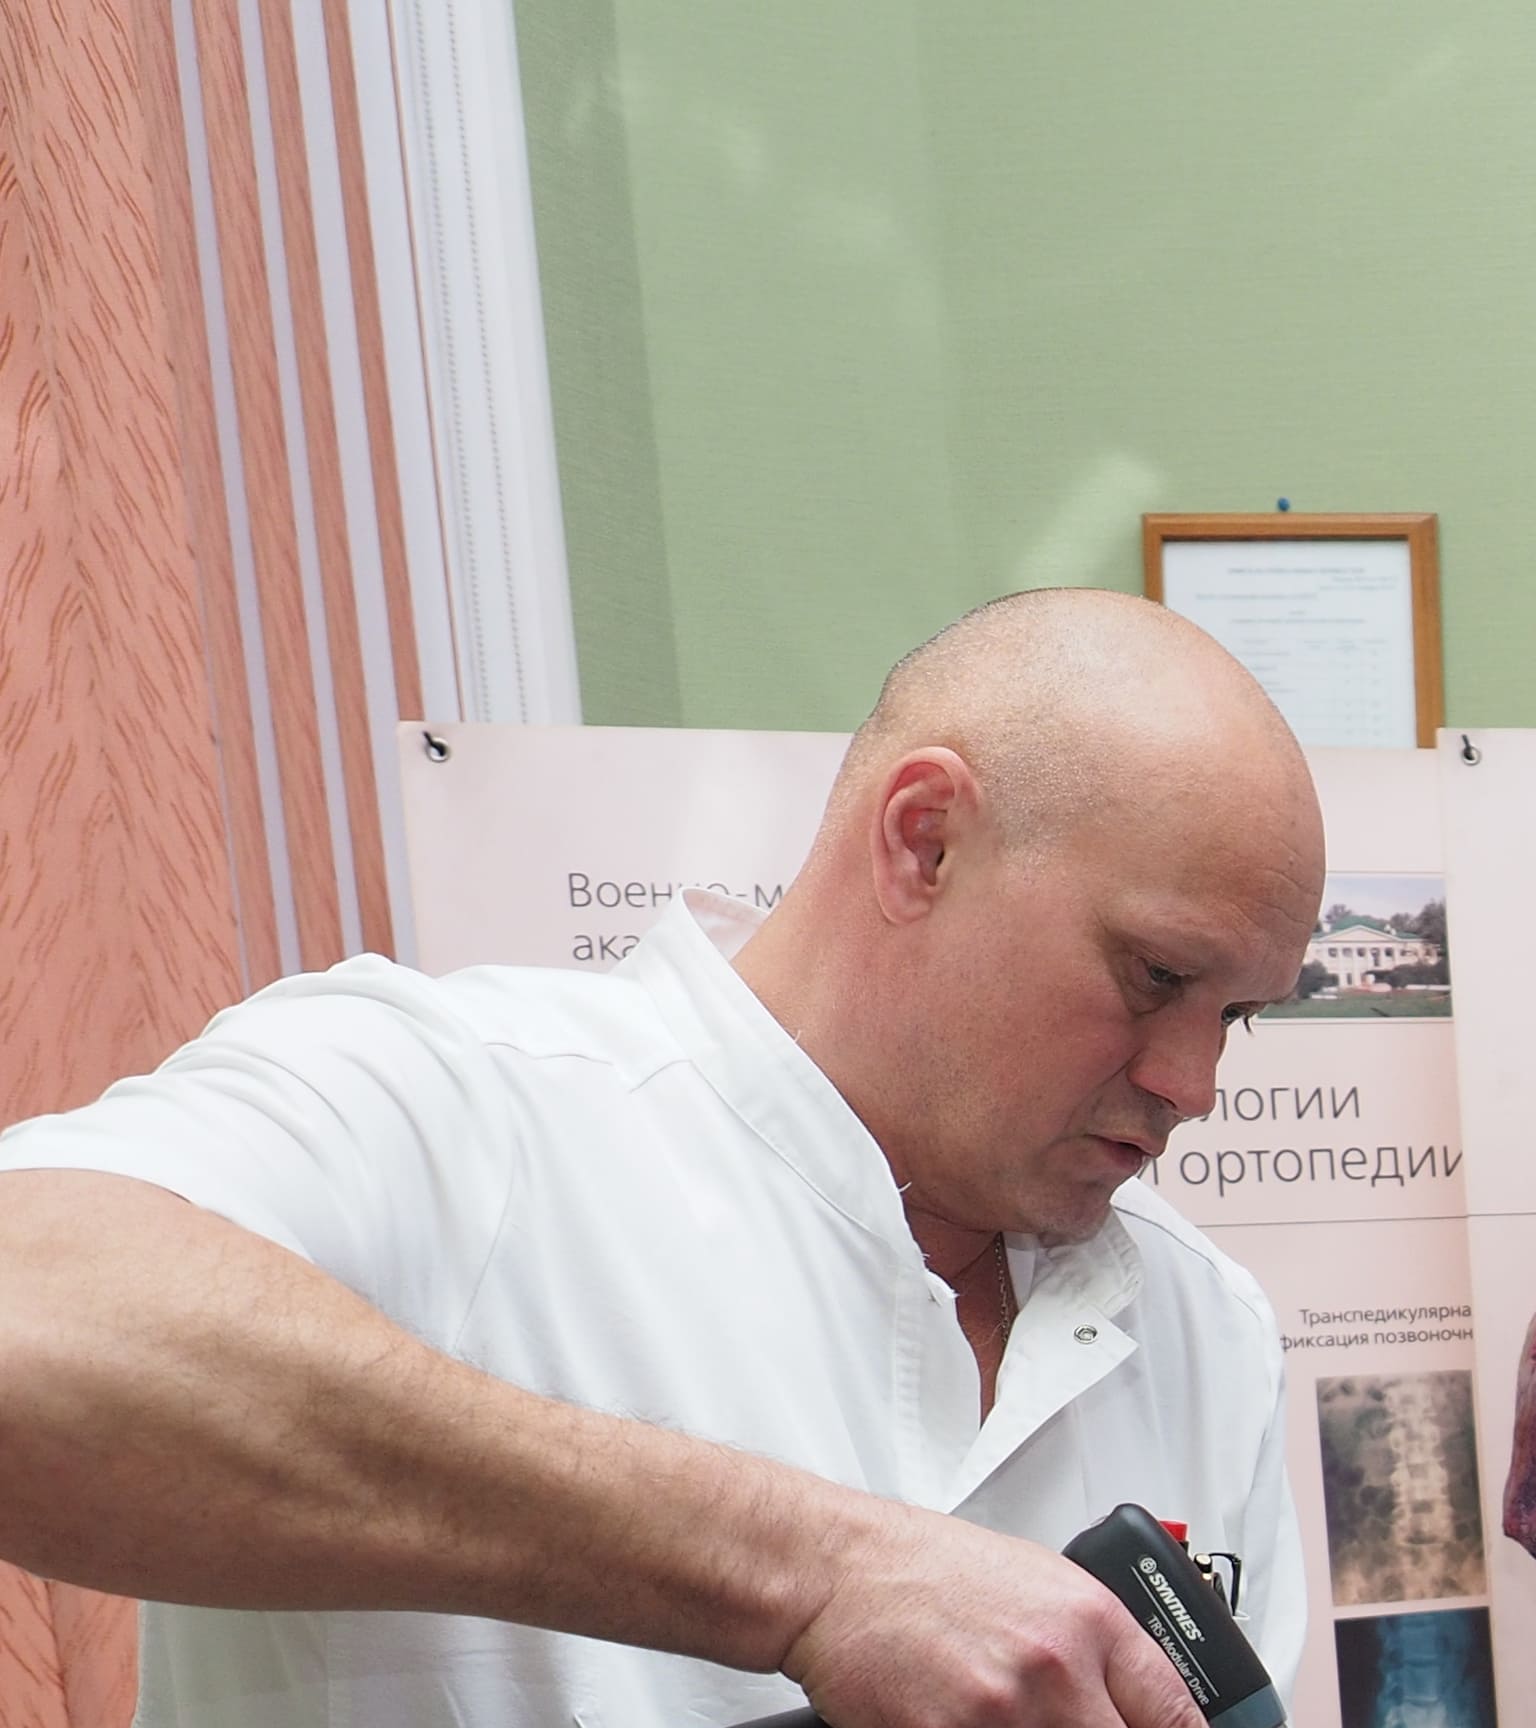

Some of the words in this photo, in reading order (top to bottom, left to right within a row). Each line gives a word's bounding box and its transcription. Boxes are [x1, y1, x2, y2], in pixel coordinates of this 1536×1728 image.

[1183, 1086, 1361, 1122] логии
[1298, 1304, 1472, 1328] Транспедикулярна
[1149, 1572, 1203, 1642] SYNTHES
[1147, 1613, 1167, 1638] TRS
[1160, 1635, 1193, 1680] Modular
[1188, 1676, 1210, 1706] Drive
